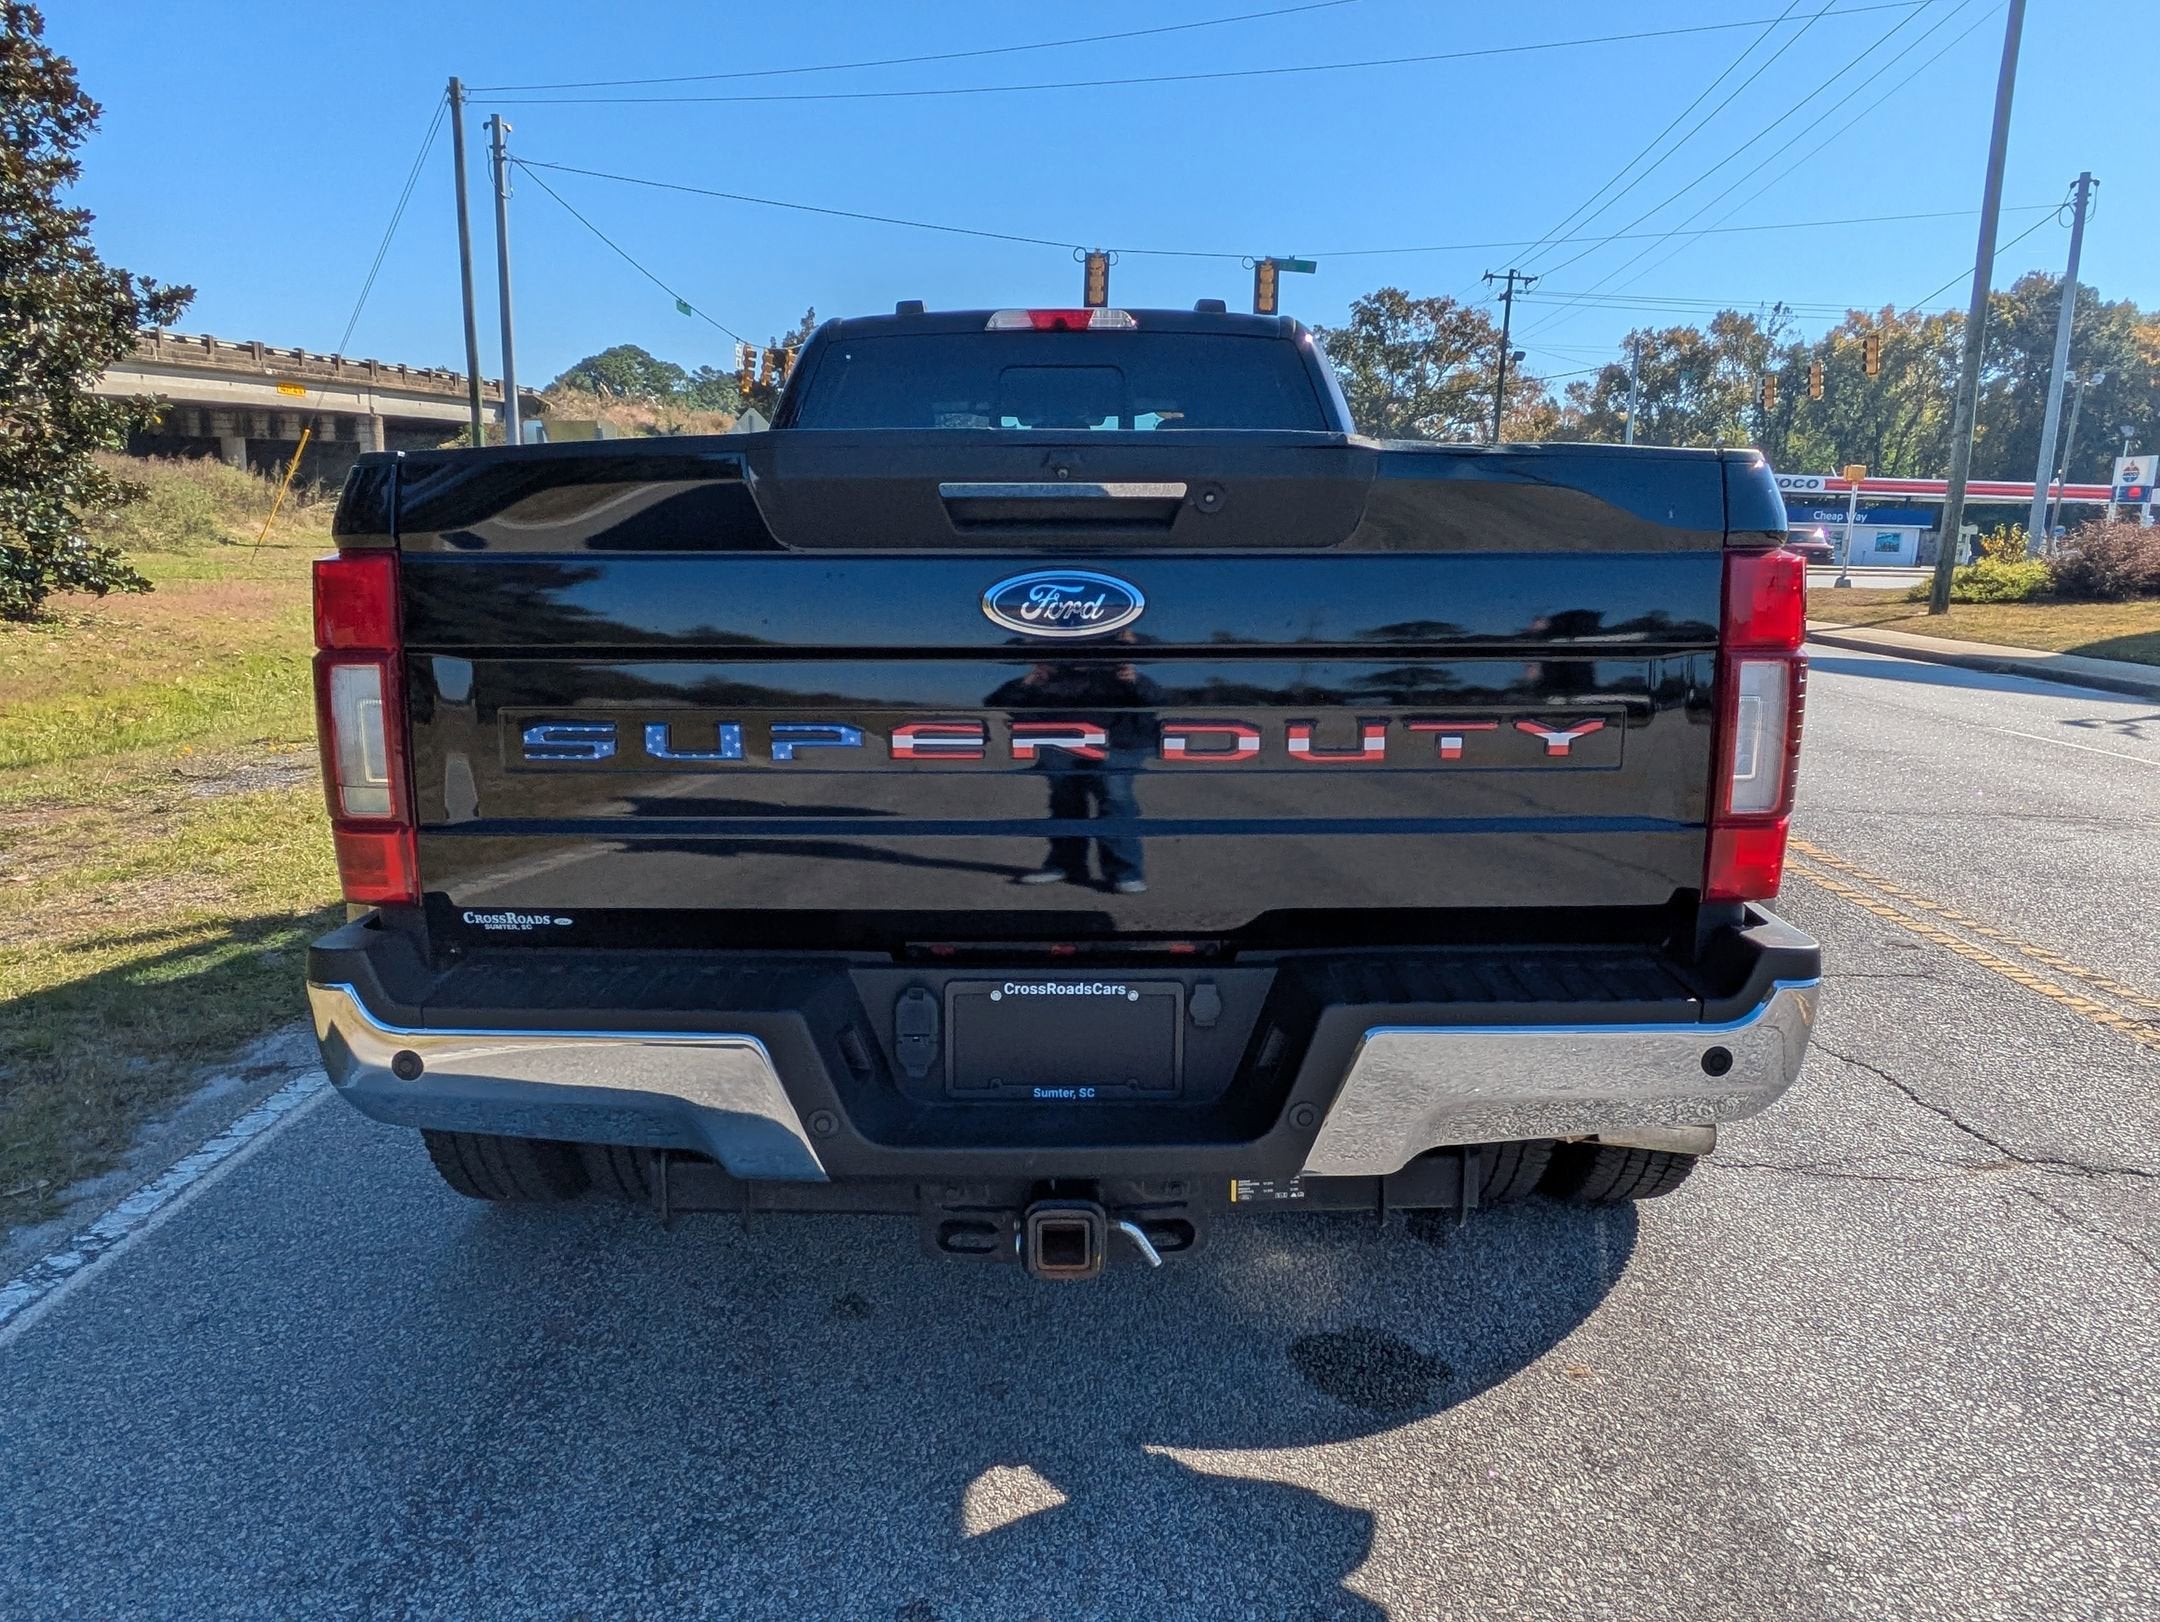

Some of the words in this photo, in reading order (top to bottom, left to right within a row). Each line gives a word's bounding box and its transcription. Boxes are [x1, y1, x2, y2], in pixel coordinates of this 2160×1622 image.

[1775, 478, 1820, 489] OCO
[1813, 511, 1844, 522] Cheap
[1020, 584, 1106, 620] Ford
[522, 720, 1107, 761] SUPER
[1159, 718, 1606, 762] DUTY
[1003, 982, 1127, 995] CrossRoadsCars
[1033, 1087, 1076, 1100] Sumter,
[1079, 1087, 1096, 1098] SC
